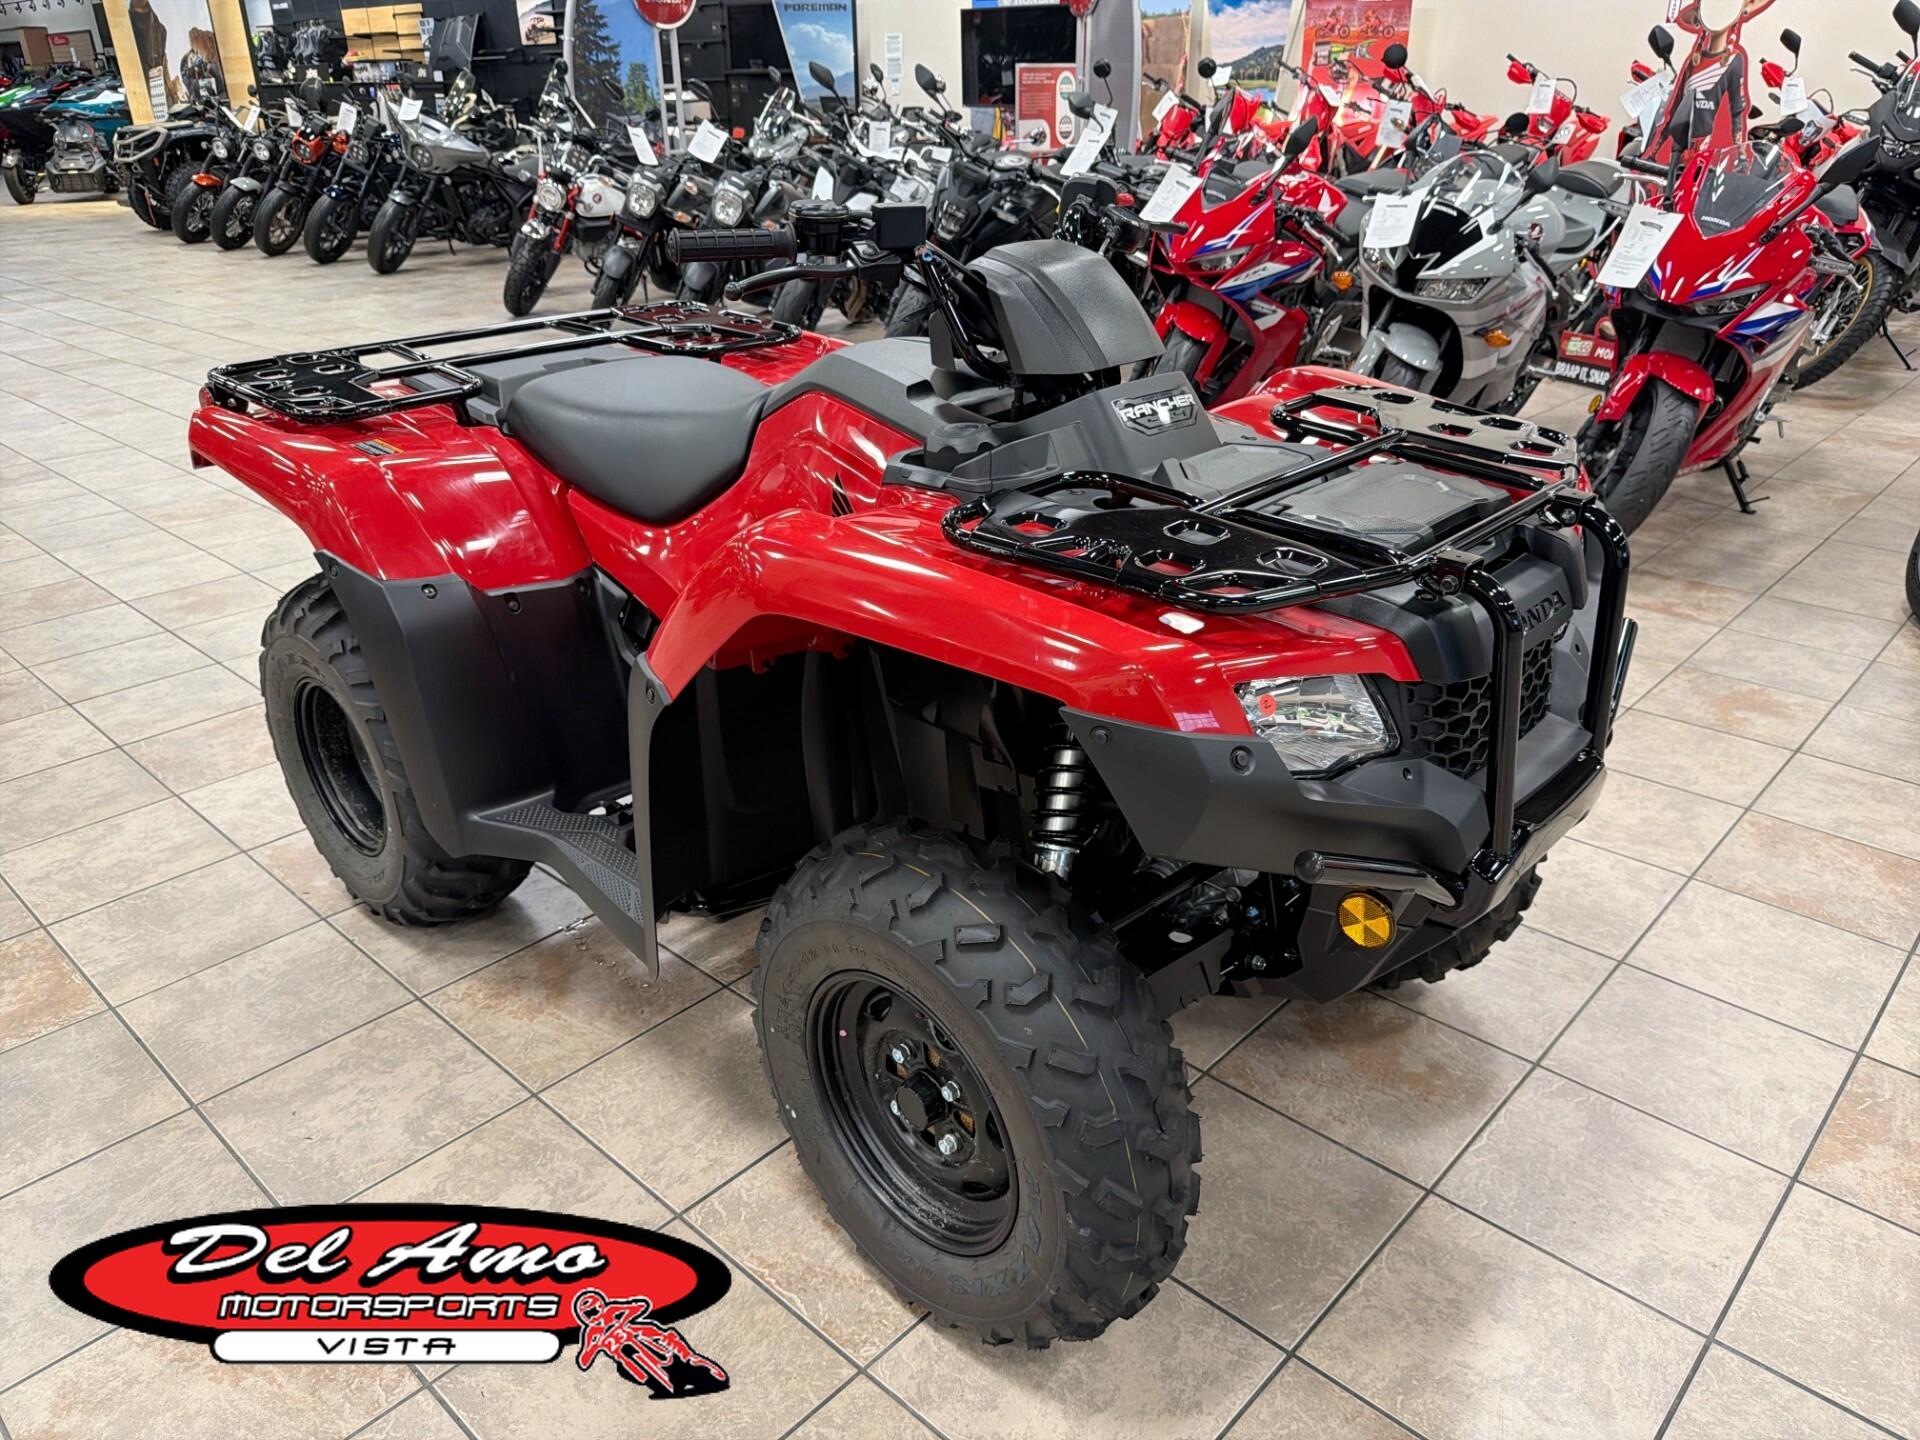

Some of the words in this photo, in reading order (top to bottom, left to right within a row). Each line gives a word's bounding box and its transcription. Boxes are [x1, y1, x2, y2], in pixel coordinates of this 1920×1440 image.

[783, 3, 847, 12] FOREMAN
[1695, 99, 1716, 110] NDA
[1700, 215, 1731, 227] HONDA
[1118, 393, 1197, 422] RANCHER
